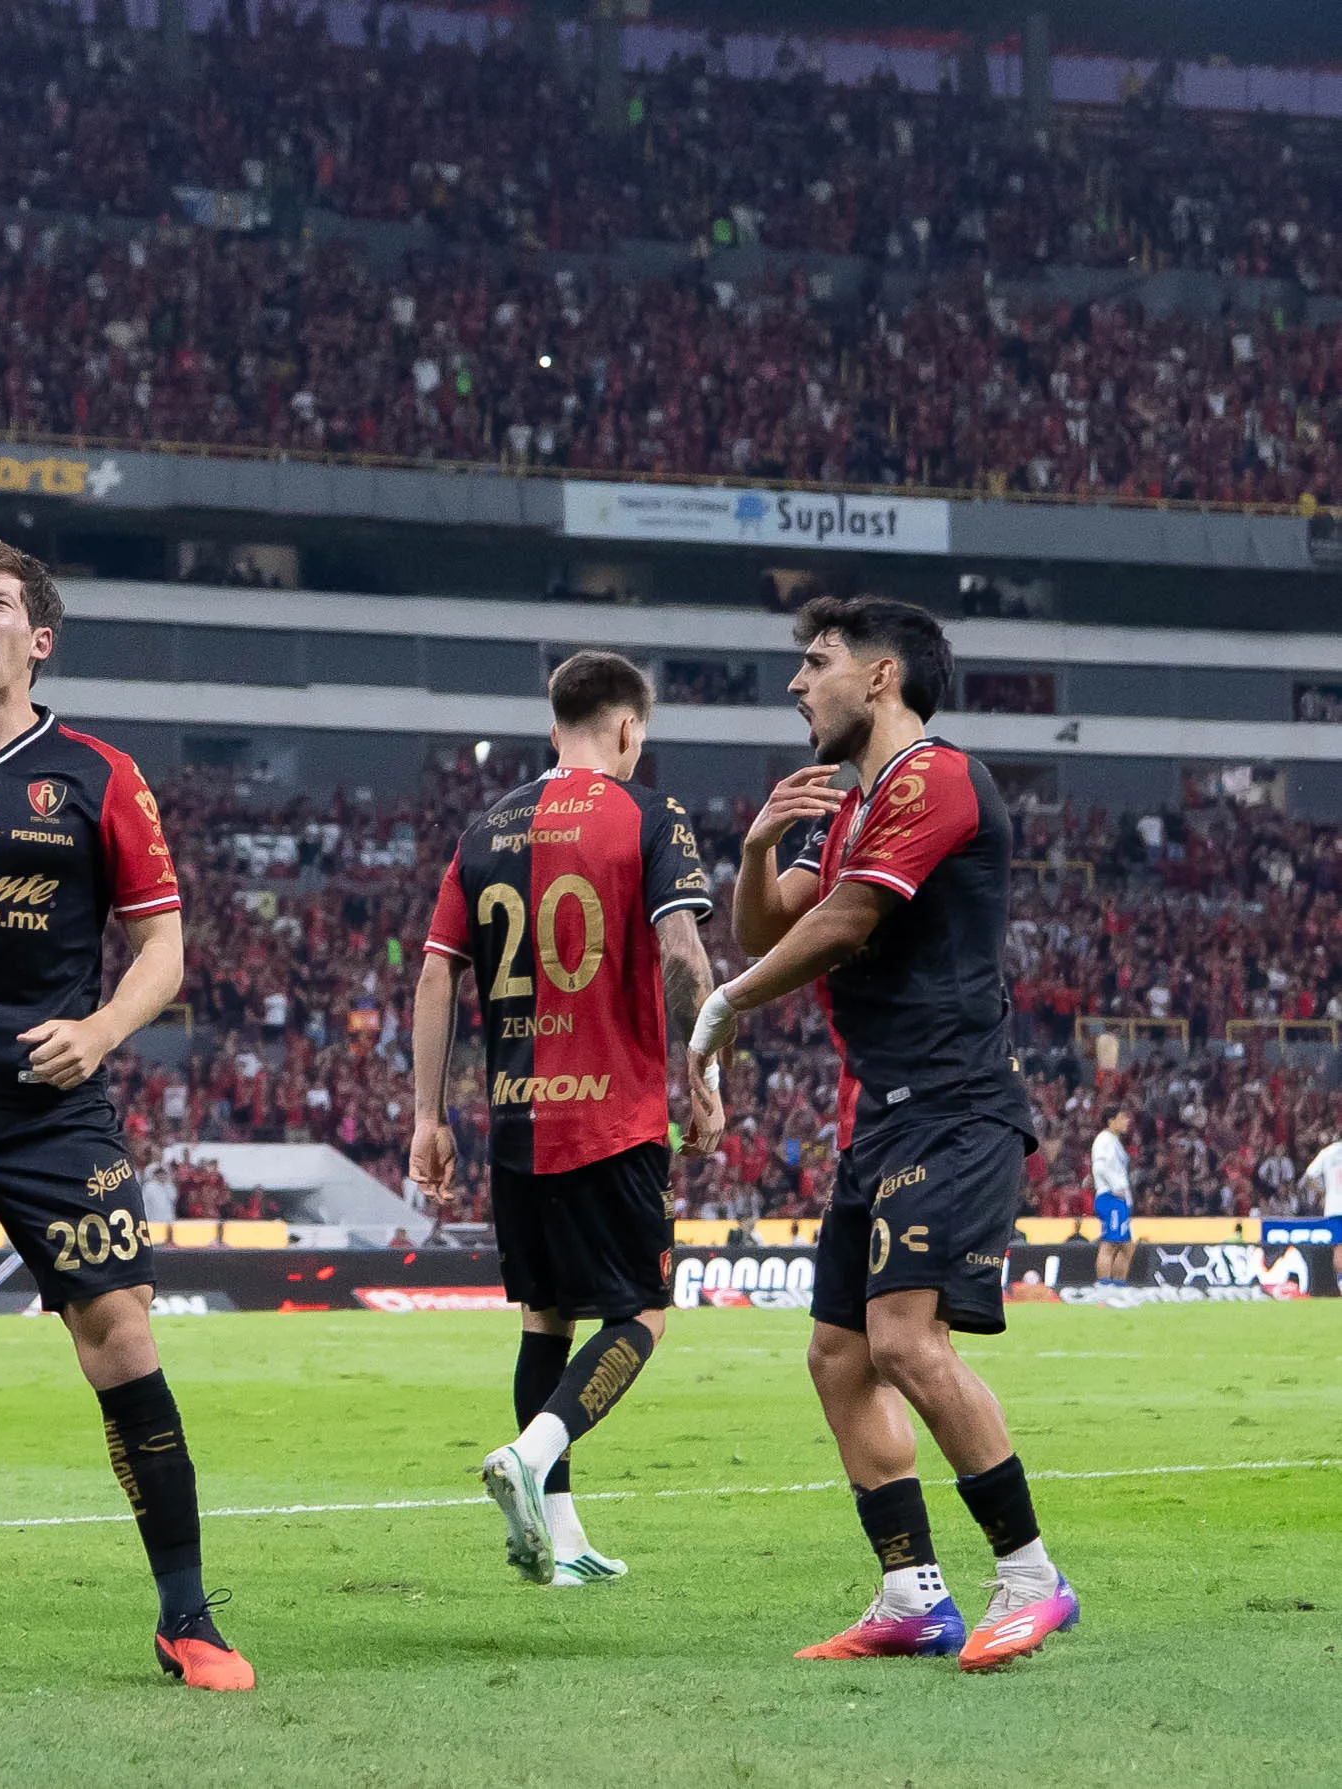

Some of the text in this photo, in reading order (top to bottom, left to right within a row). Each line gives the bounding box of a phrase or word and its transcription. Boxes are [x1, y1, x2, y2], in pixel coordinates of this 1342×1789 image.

[775, 495, 898, 541] Suplast
[543, 797, 595, 815] Atlas
[11, 829, 75, 847] PERDURA
[478, 873, 605, 1000] 20
[501, 1009, 573, 1038] ZENÓN
[491, 1072, 611, 1107] AKRON
